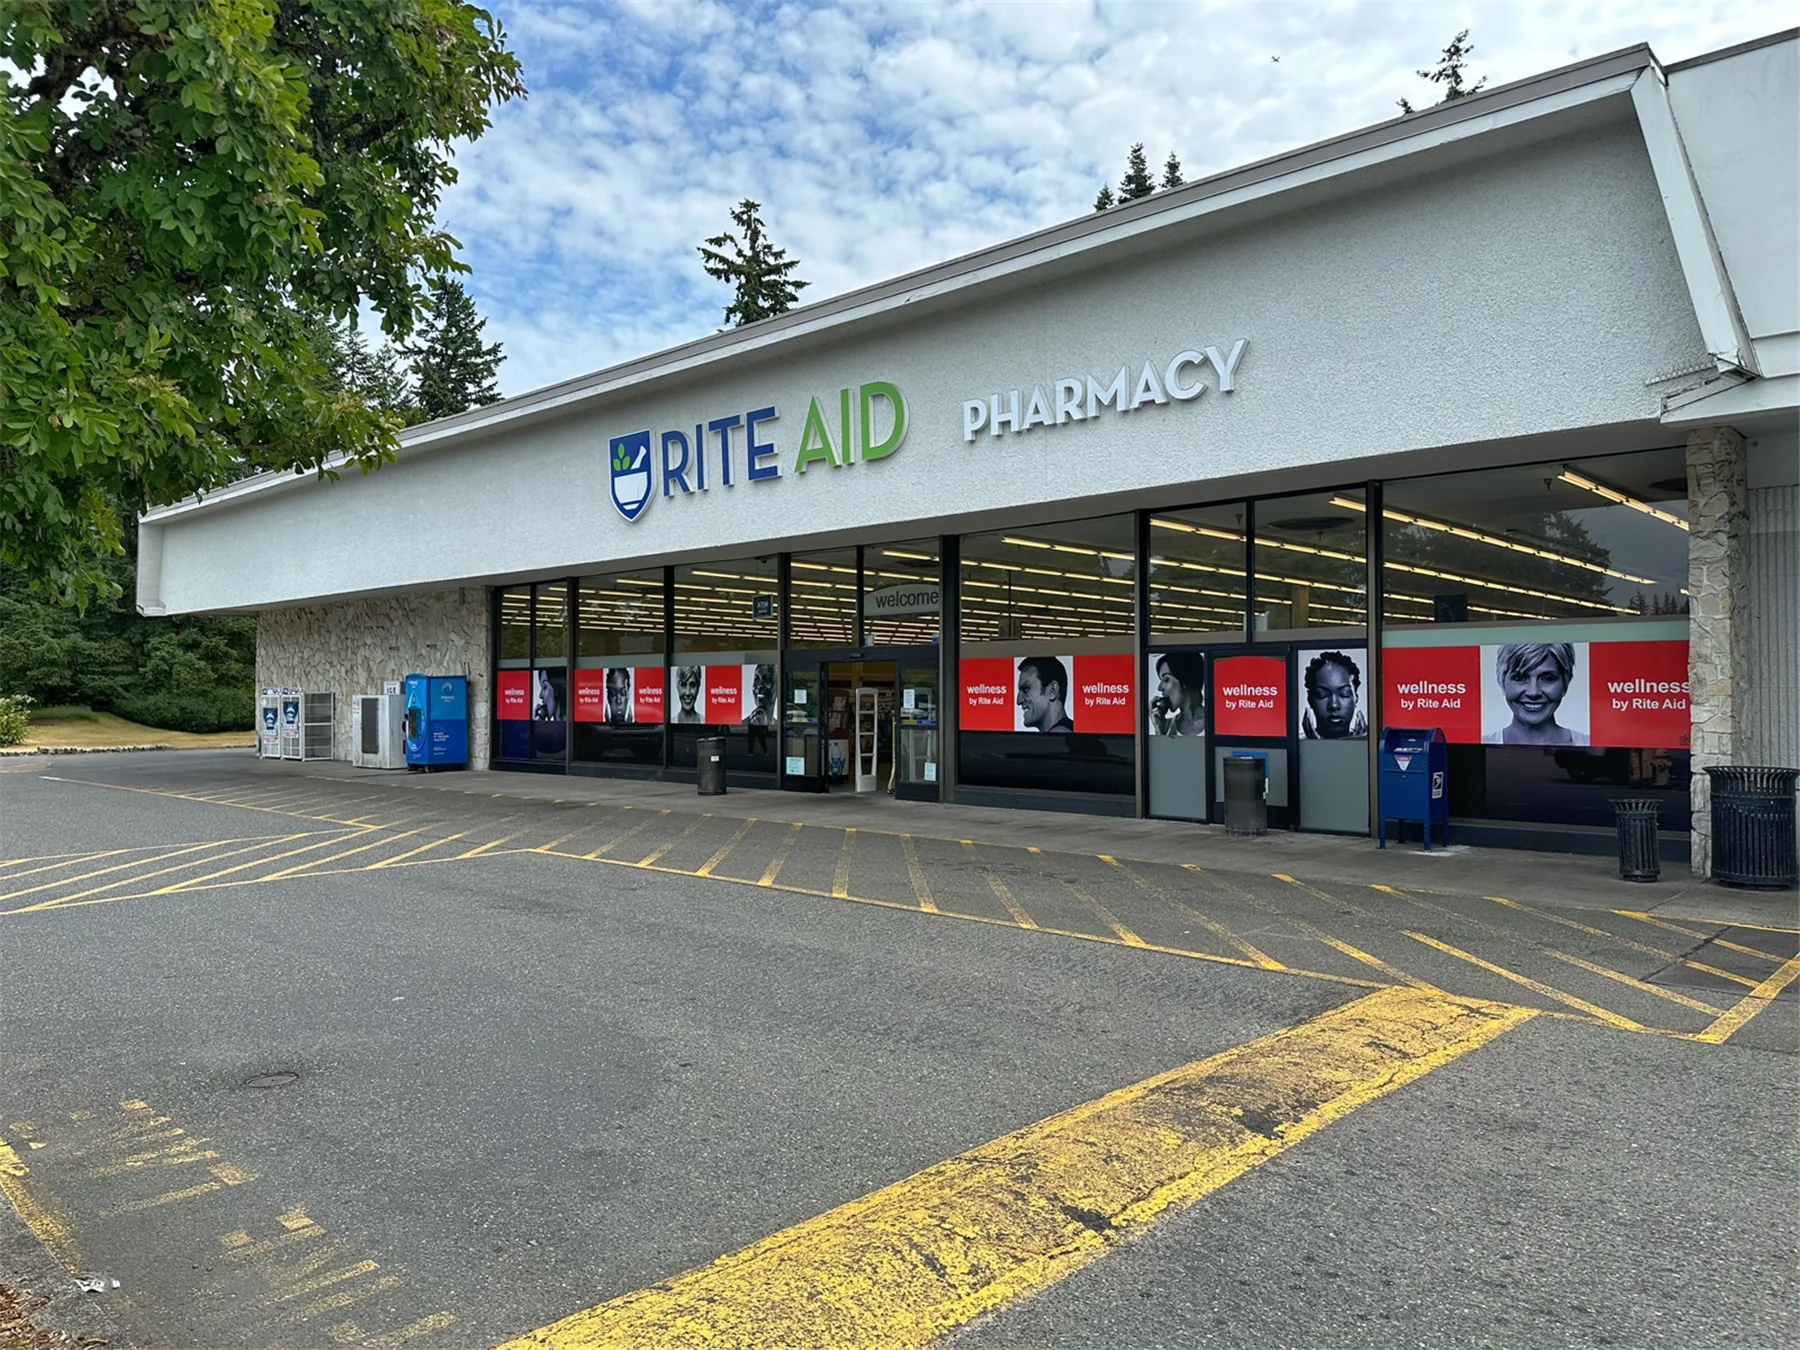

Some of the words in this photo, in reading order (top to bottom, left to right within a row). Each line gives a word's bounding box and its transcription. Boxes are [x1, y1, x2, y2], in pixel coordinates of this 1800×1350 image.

[963, 338, 1249, 442] PHARMACY
[660, 405, 782, 497] RITE
[794, 380, 910, 474] AID
[756, 600, 769, 609] ATM
[875, 589, 940, 609] welcome
[386, 687, 397, 695] ICE
[578, 687, 601, 695] wellness
[638, 686, 663, 695] wellness
[710, 686, 738, 695] wellness
[966, 683, 1007, 695] wellness
[1082, 682, 1130, 694] wellness
[1222, 684, 1278, 696] wellness
[1396, 680, 1467, 695] wellness
[1607, 678, 1690, 694] wellness
[504, 688, 525, 696] wellness
[711, 697, 718, 705] by
[968, 697, 978, 707] by
[978, 697, 992, 705] Rite
[991, 697, 1004, 705] Aid
[1084, 697, 1095, 707] by
[1095, 697, 1112, 706] Rite
[1111, 697, 1126, 706] Aid
[1225, 700, 1237, 711] by
[1238, 700, 1257, 709] Rite
[1257, 700, 1274, 709] Aid
[1400, 699, 1415, 711] by
[1417, 699, 1440, 709] Rite
[1441, 699, 1462, 709] Aid
[1612, 698, 1629, 712] by
[1632, 699, 1660, 710] Rite
[1661, 698, 1686, 710] Aid
